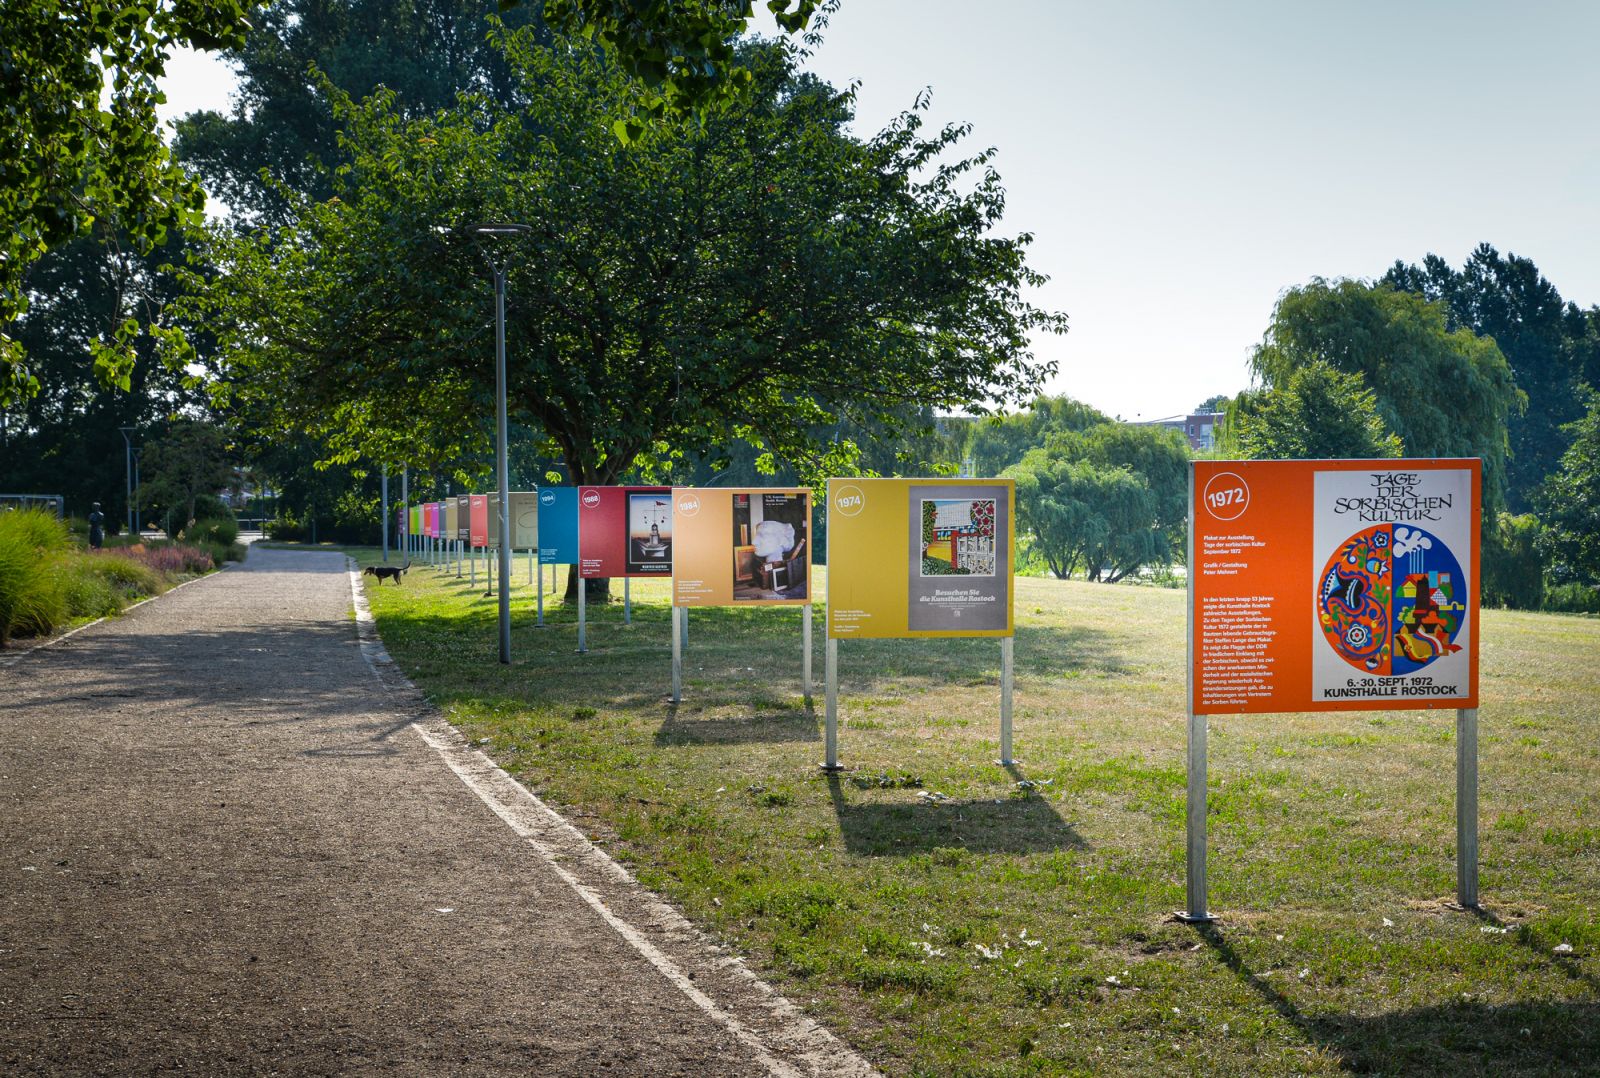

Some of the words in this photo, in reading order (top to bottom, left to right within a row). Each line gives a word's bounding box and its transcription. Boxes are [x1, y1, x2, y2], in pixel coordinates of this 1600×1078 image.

[1370, 472, 1422, 486] TAGE
[1208, 488, 1244, 508] 1972
[1377, 486, 1420, 498] DER
[838, 496, 861, 508] 1974
[1334, 494, 1452, 514] SORBISCHEN
[1358, 509, 1442, 522] KULTUR
[1378, 677, 1408, 686] SEPT.
[1410, 677, 1433, 686] 1972
[1324, 687, 1397, 698] KUNSTHALLE
[1401, 686, 1457, 696] ROSTOCK
